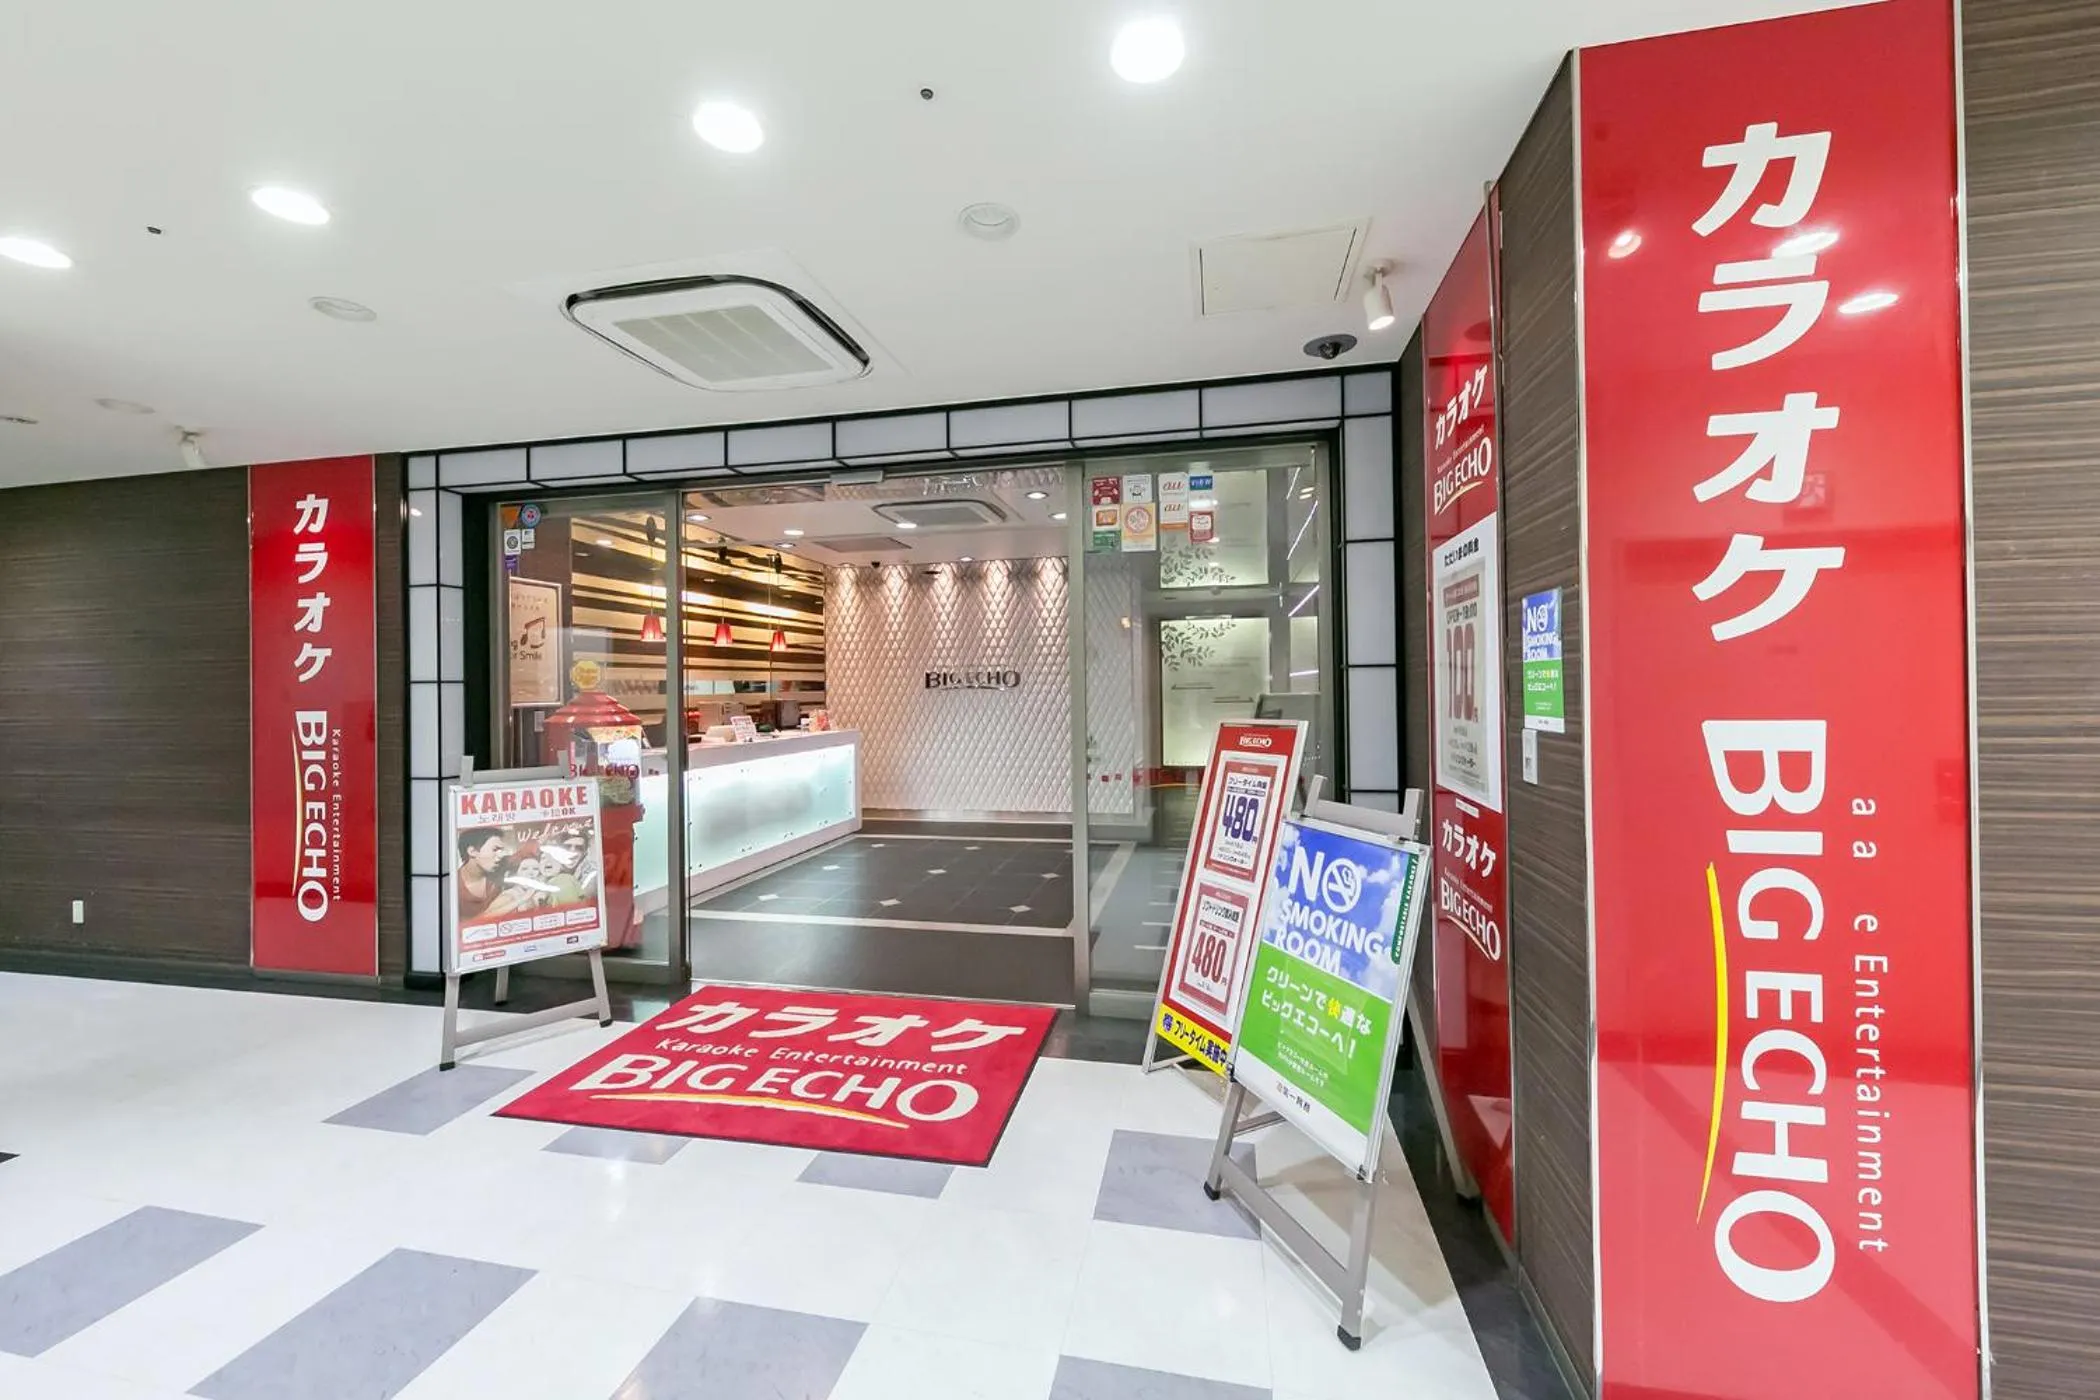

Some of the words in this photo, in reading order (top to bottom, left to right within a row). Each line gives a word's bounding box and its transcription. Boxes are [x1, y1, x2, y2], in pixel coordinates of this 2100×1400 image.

[1434, 364, 1488, 450] カラオケ
[1691, 121, 1846, 642] カラオケ
[1162, 481, 1185, 492] au
[1164, 502, 1184, 513] au
[1433, 471, 1454, 516] BIG
[1455, 436, 1493, 485] ECHO
[292, 493, 333, 683] カラオケ
[925, 671, 962, 689] BIG
[965, 670, 1021, 688] ECHO
[295, 710, 328, 792] BIG
[331, 728, 342, 788] Karaoke
[461, 786, 589, 816] KARAOKE
[1701, 719, 1828, 941] BIG
[296, 801, 329, 923] ECHO
[331, 793, 343, 902] Entertainment
[1441, 819, 1496, 878] カラオケ
[1274, 926, 1341, 975] ROOM
[1280, 898, 1384, 959] SMOKING
[1440, 876, 1462, 917] BIG
[1462, 899, 1501, 961] ECHO
[655, 1000, 1028, 1054] カラオケ
[1266, 966, 1372, 1035] クリーンで快適な
[567, 1053, 746, 1093] BIG
[750, 1065, 979, 1122] ECHO
[655, 1036, 760, 1060] Karaoke
[769, 1046, 969, 1076] Entertainment
[1714, 970, 1836, 1303] ECHO
[1852, 954, 1890, 1253] Entertainment
